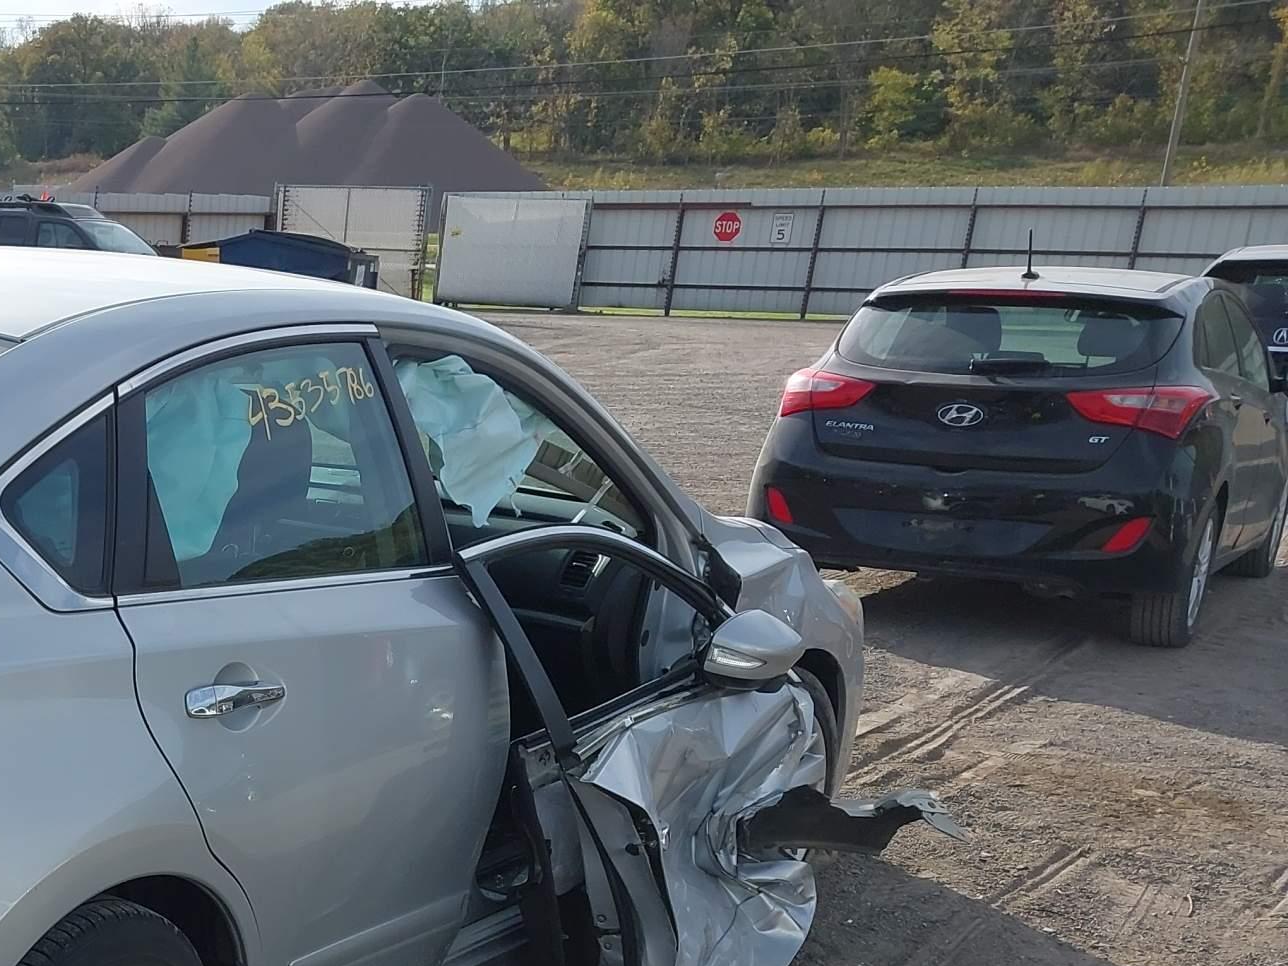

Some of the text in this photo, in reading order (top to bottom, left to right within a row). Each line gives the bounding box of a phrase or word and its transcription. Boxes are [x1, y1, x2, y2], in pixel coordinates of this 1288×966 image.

[715, 221, 740, 233] STOP
[776, 229, 785, 240] 5
[247, 367, 374, 440] 43535786
[824, 420, 874, 431] ELANTRA
[1089, 436, 1110, 444] GT
